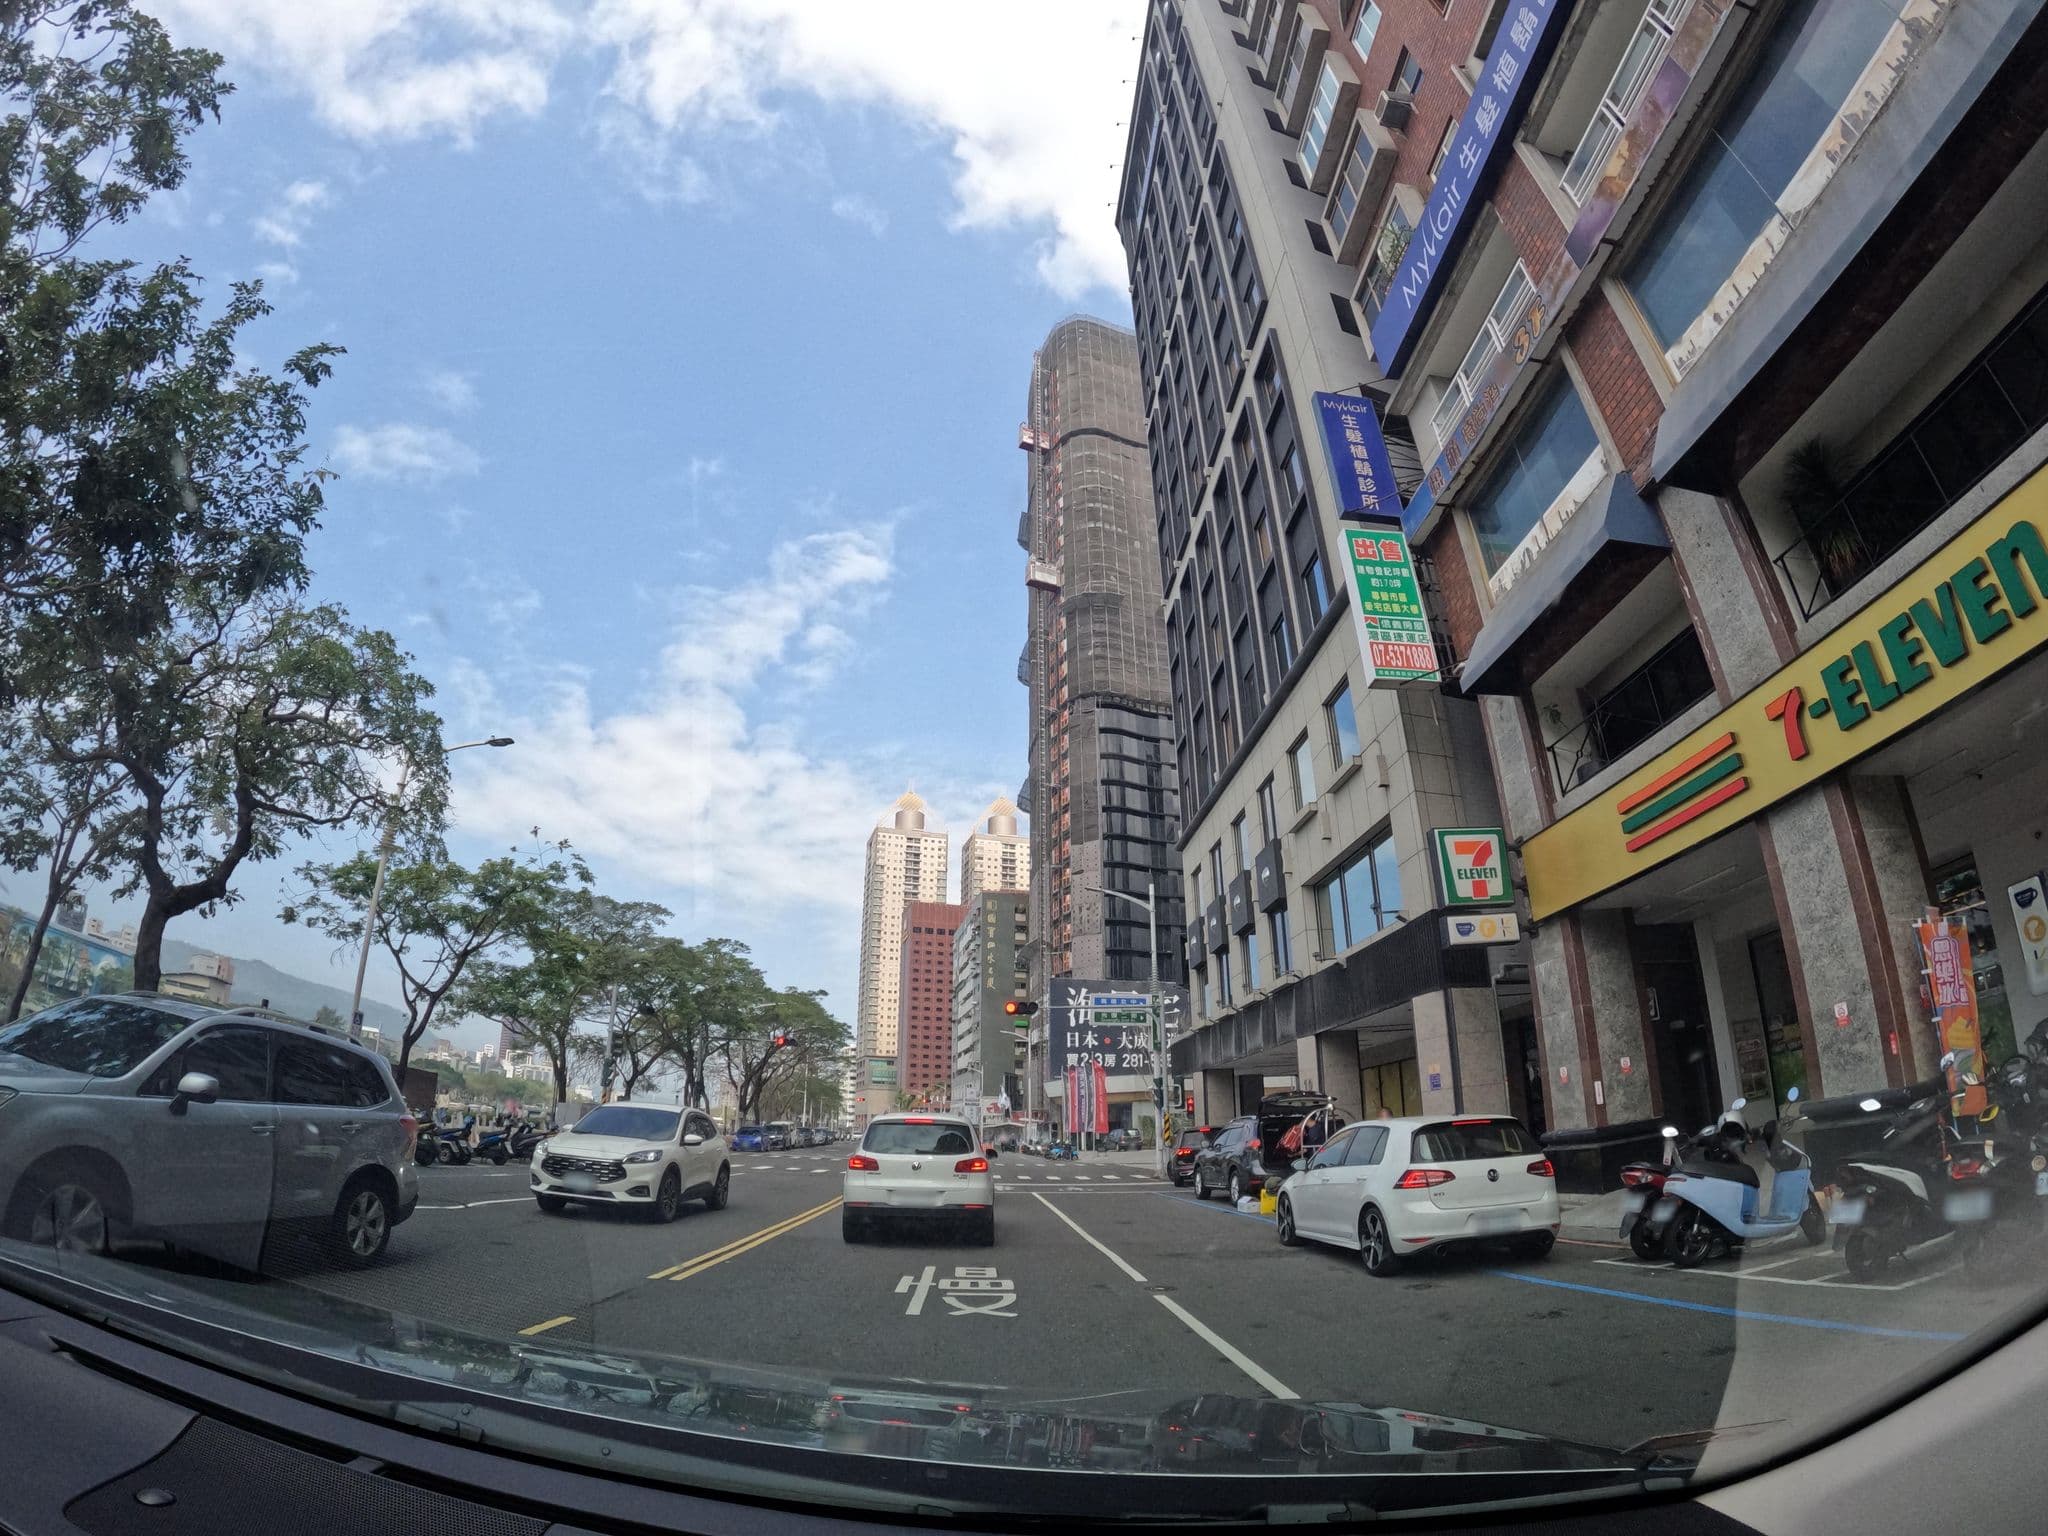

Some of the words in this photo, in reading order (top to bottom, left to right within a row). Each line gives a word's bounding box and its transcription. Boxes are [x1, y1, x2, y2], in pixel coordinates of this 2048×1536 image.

[1460, 0, 1549, 179] 生髮植鬍
[1353, 538, 1405, 563] 出售
[1372, 643, 1433, 669] 07-5371888
[1067, 1031, 1099, 1049] 日本
[894, 1265, 1018, 1316] 慢
